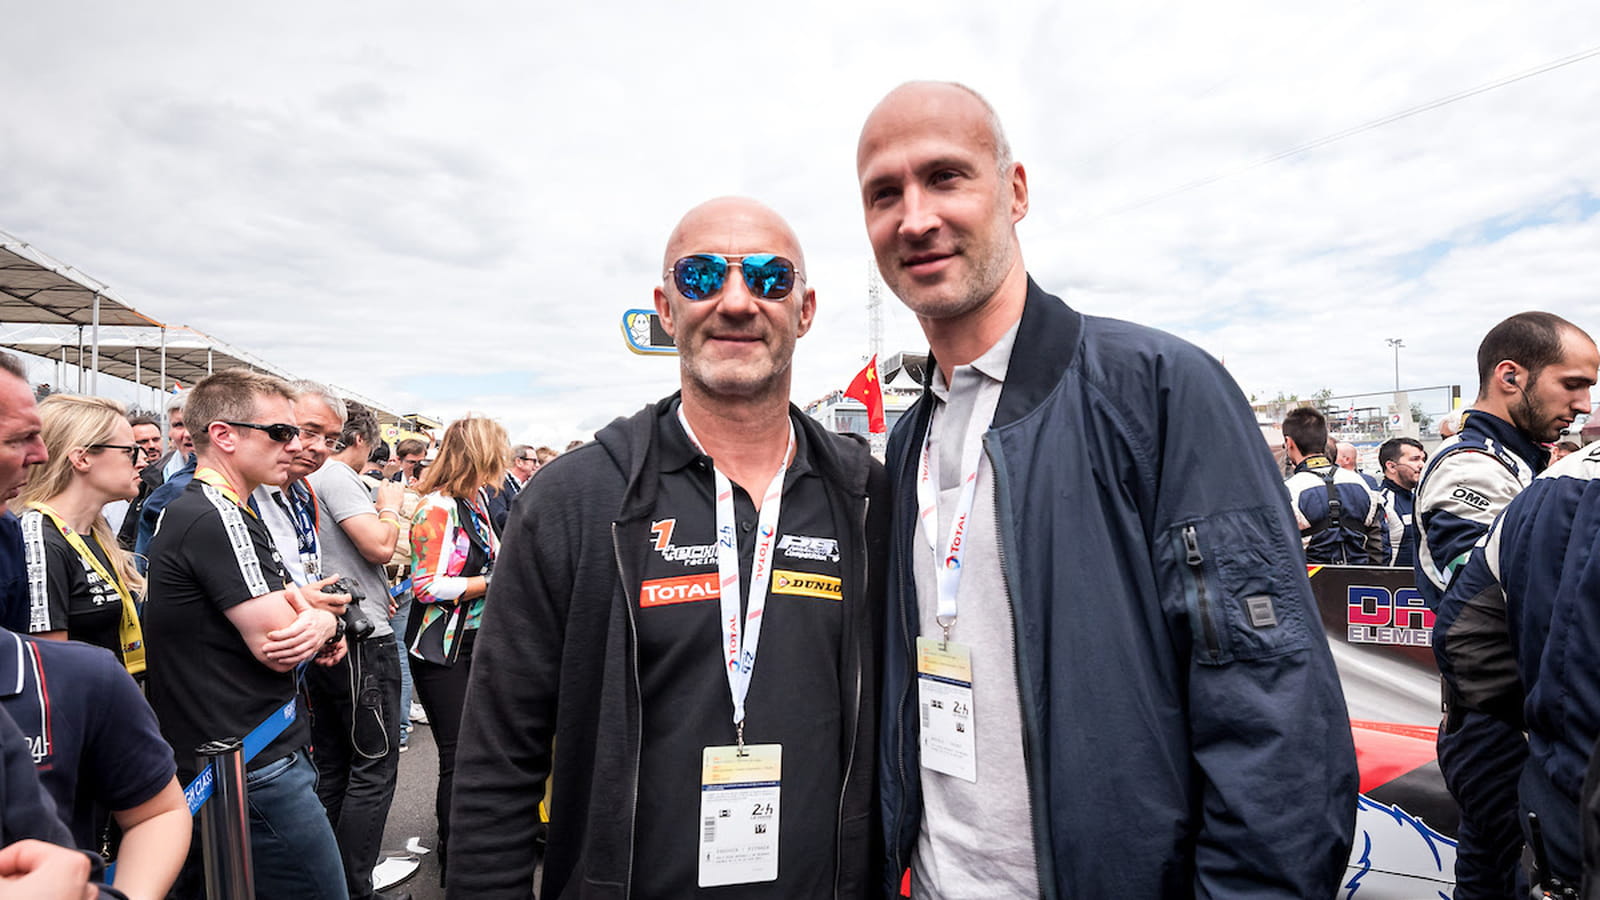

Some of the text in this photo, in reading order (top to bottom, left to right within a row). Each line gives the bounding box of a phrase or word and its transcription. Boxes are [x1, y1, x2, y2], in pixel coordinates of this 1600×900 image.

[1452, 488, 1491, 507] OMP
[950, 512, 967, 553] TOTAL
[756, 541, 769, 581] TOTAL
[642, 582, 719, 603] TOTAL
[729, 614, 738, 655] TOTAL
